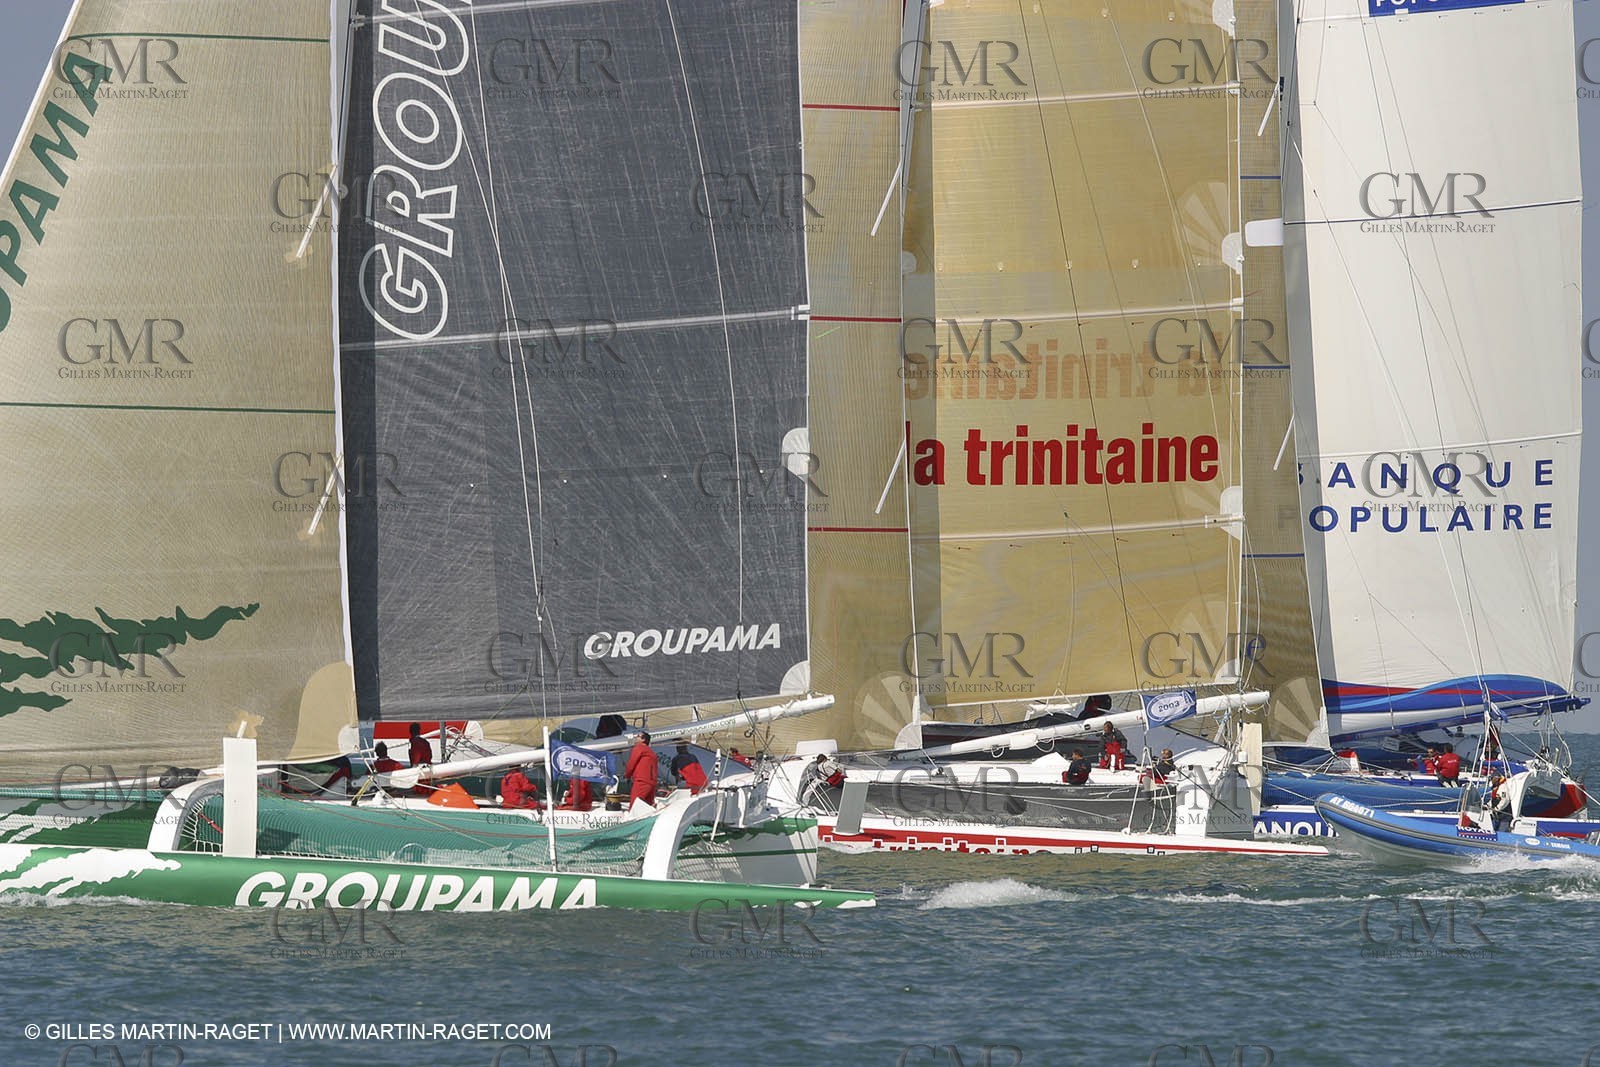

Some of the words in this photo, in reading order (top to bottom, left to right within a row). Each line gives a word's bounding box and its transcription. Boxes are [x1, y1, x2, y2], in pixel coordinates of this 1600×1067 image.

[964, 422, 1219, 486] trinitaine
[1298, 460, 1553, 494] ANQUE
[1309, 503, 1553, 533] OPULAIRE
[584, 623, 781, 660] GROUPAMA
[565, 757, 594, 770] 2003
[1254, 821, 1338, 837] ANQU
[235, 871, 598, 912] GROUPAMA
